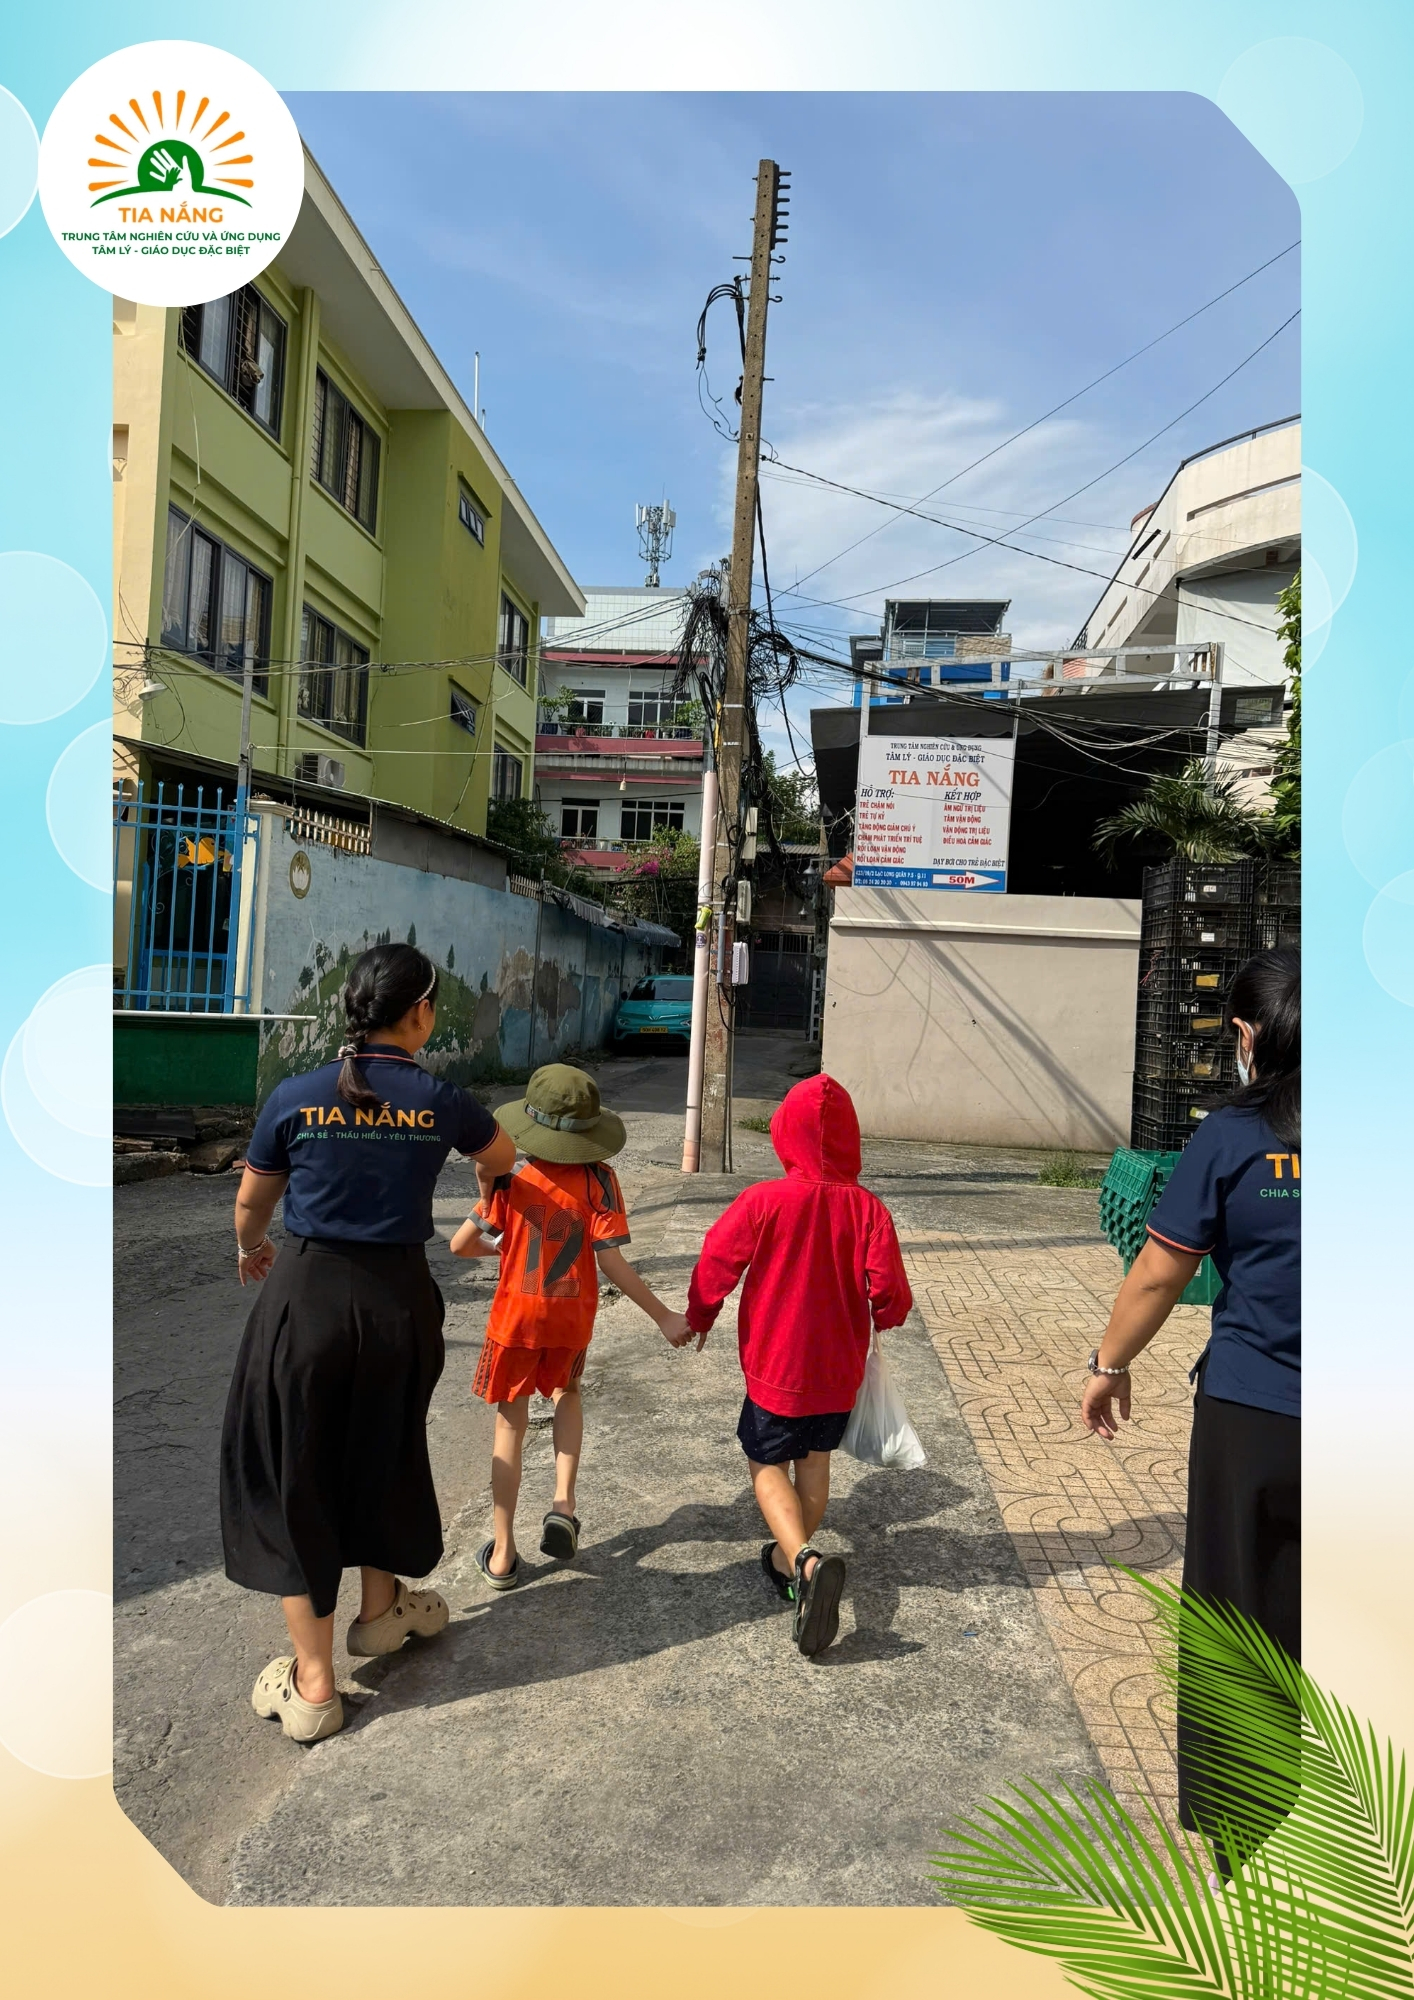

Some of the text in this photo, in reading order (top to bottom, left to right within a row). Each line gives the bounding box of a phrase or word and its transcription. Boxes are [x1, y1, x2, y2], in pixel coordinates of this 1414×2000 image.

[886, 752, 901, 761] TÂM
[903, 752, 911, 761] LÝ
[918, 753, 934, 762] GIÁO
[936, 755, 950, 763] DỤC
[953, 755, 966, 763] ĐẶC
[969, 755, 985, 764] BIỆT
[889, 764, 980, 787] TIA NẮNG
[944, 788, 981, 803] KẾT HỢP
[949, 876, 975, 884] 50M
[300, 1102, 435, 1128] TIA NẮNG
[297, 1132, 315, 1140] CHIA
[336, 1130, 359, 1139] THẤU
[362, 1130, 381, 1140] HIỂU
[389, 1133, 405, 1141] YÊU
[1260, 1189, 1289, 1198] CHIA
[521, 1204, 585, 1297] 12
